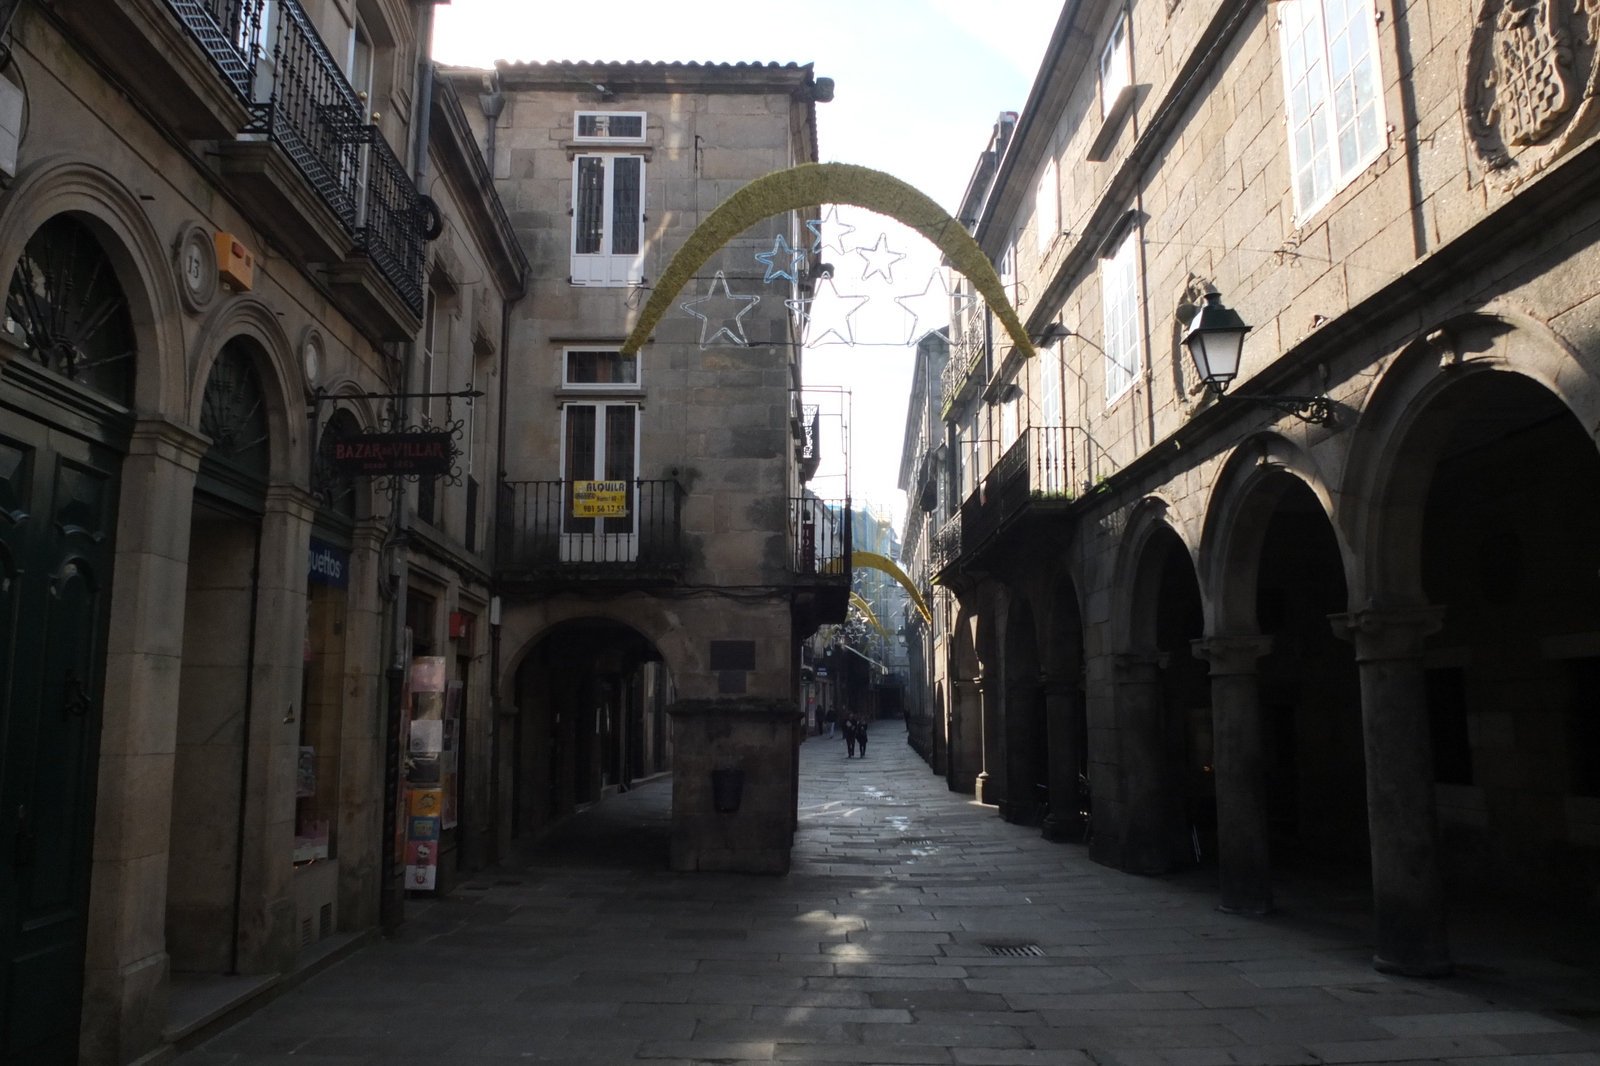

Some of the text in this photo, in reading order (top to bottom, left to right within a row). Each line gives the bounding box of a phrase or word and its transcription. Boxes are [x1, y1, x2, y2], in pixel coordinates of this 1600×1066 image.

[187, 255, 199, 278] 13
[336, 444, 383, 460] BAZAR
[392, 443, 444, 459] VILLAR
[587, 483, 625, 492] ALQUILA
[583, 505, 594, 513] 981
[597, 505, 605, 513] 56
[607, 505, 615, 513] 17
